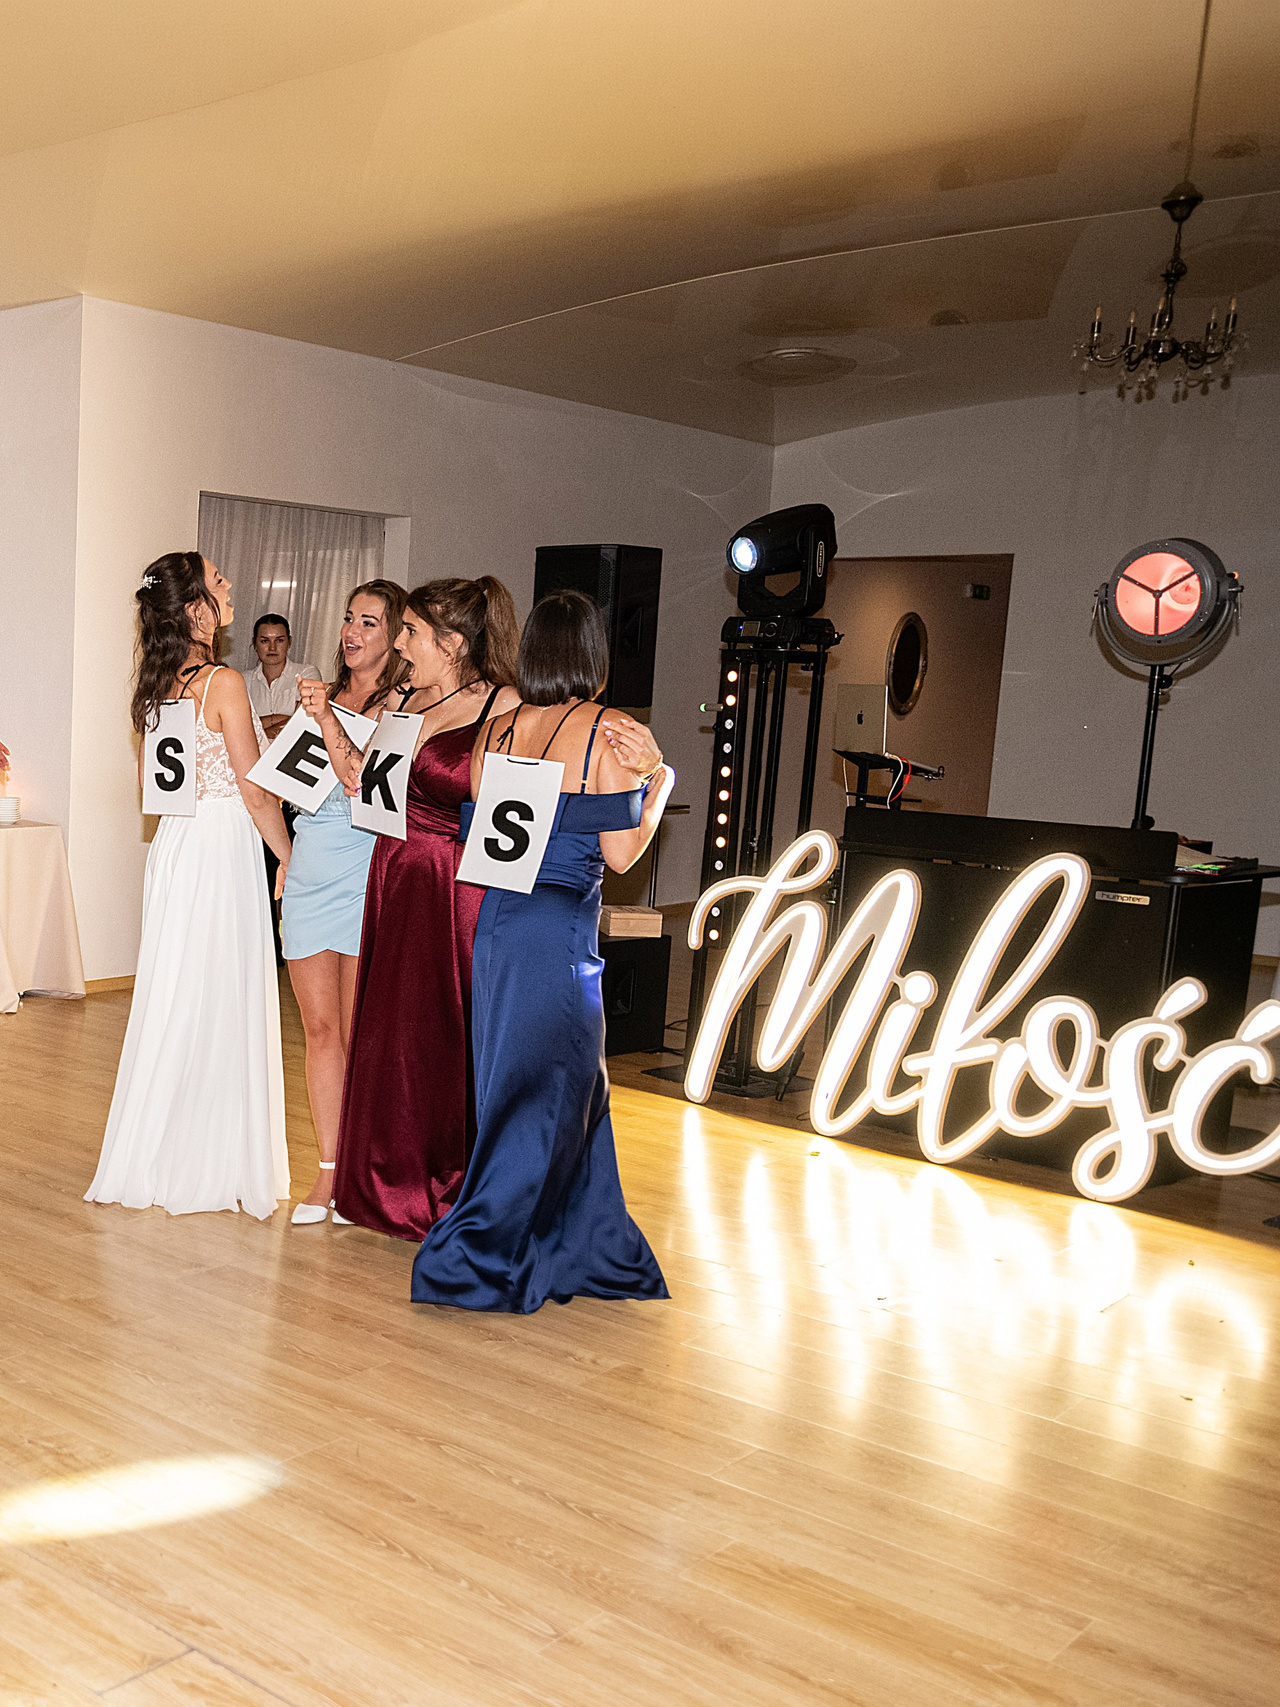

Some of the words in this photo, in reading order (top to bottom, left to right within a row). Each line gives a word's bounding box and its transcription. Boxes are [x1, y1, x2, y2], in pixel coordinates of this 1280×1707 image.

[154, 737, 185, 792] S
[275, 729, 330, 788] E
[360, 749, 404, 814] K
[483, 800, 535, 863] S
[684, 829, 1280, 1203] Miłość
